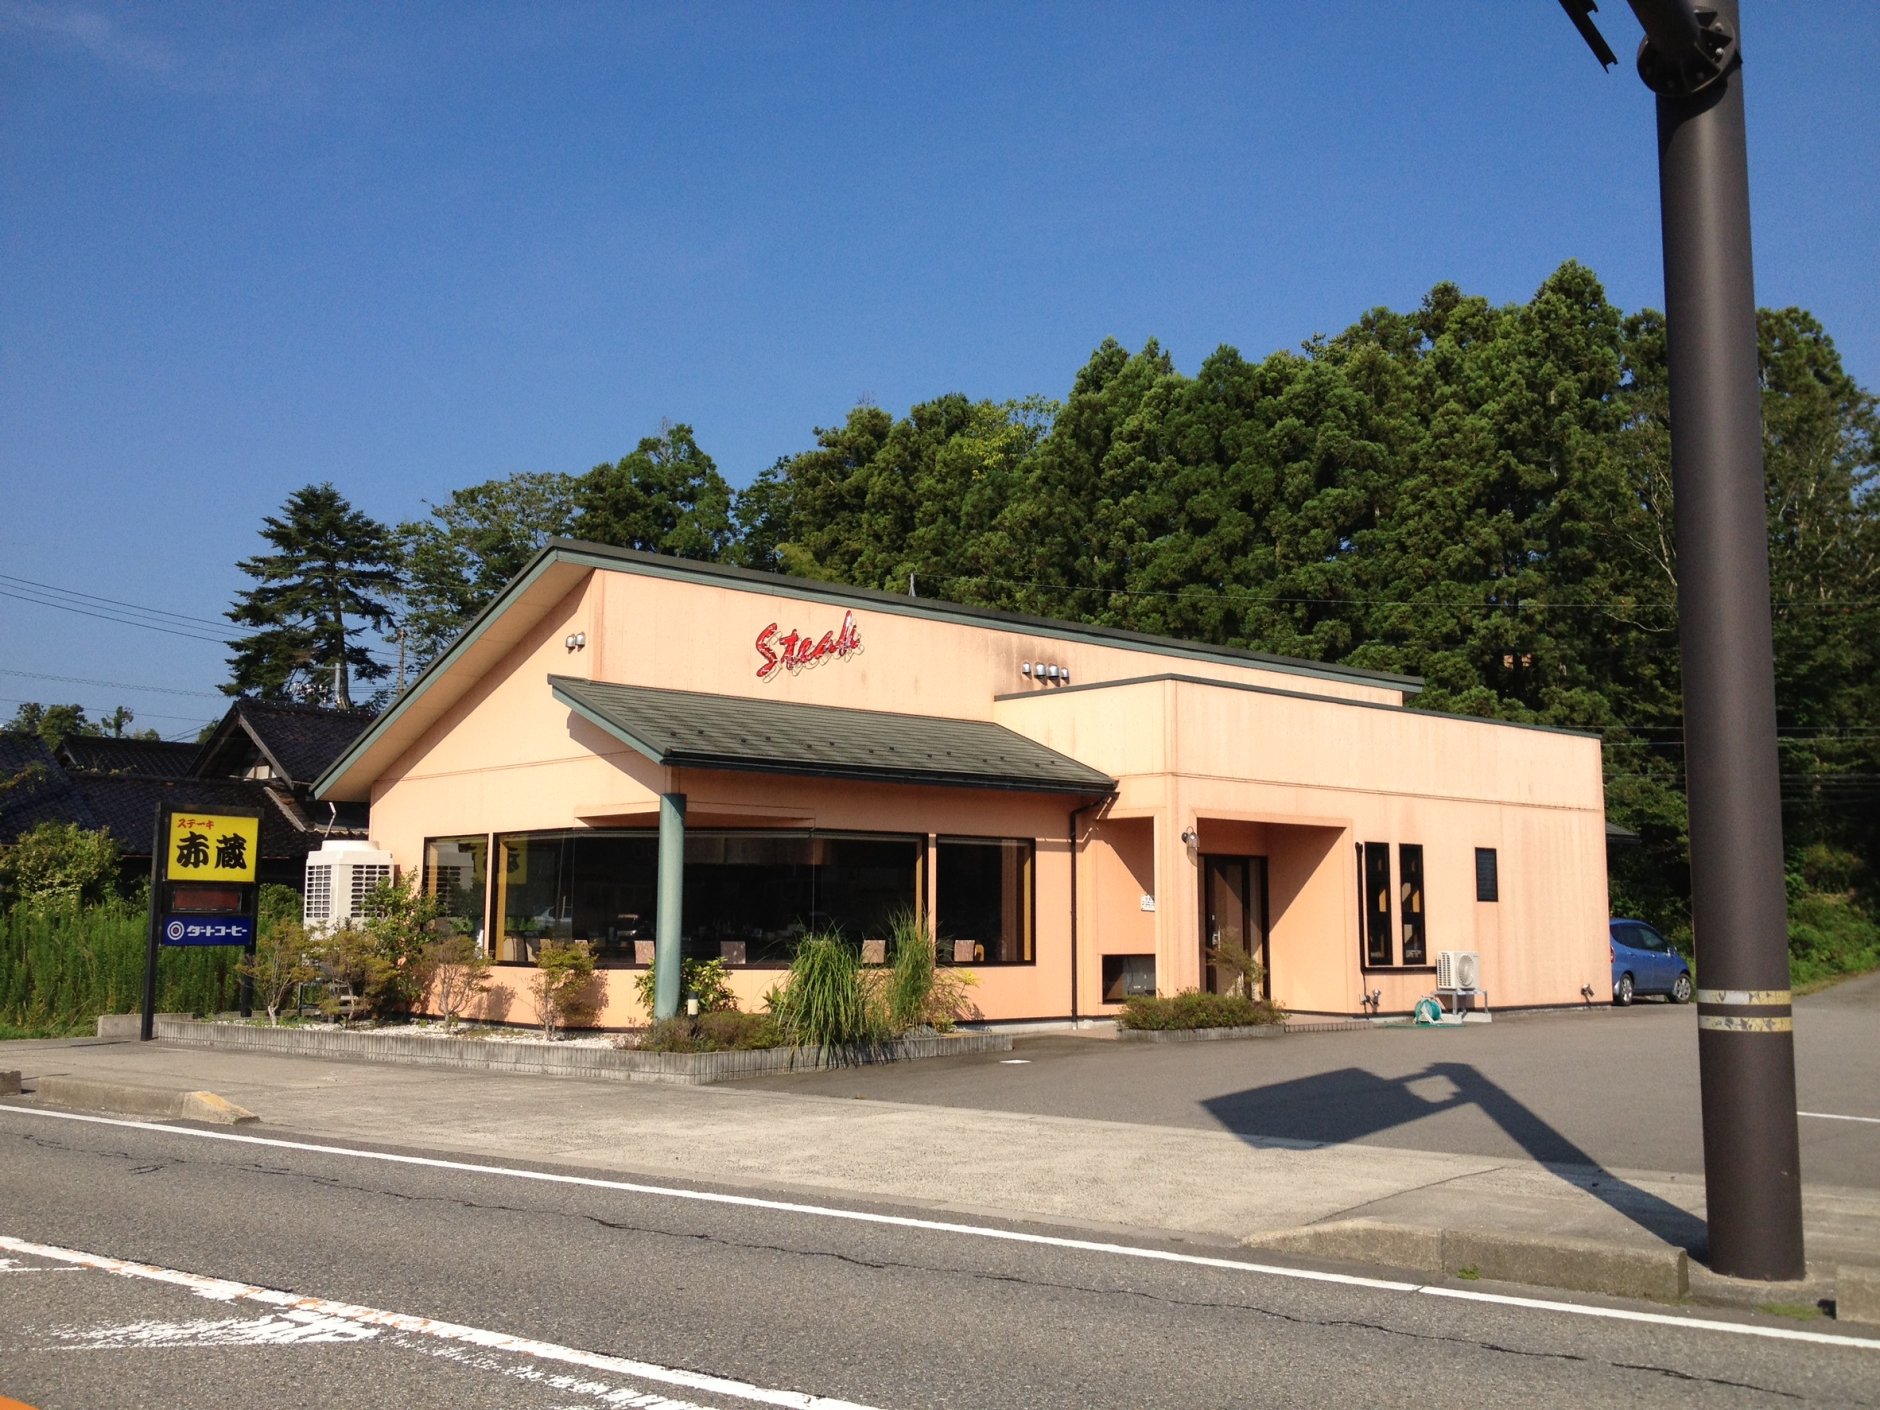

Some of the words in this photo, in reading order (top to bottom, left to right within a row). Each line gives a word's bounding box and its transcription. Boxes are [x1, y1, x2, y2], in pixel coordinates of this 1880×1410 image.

[756, 610, 861, 678] Steak
[177, 818, 215, 830] ステーキ
[176, 831, 247, 870] 赤蔵
[186, 925, 248, 937] ダートコーヒー
